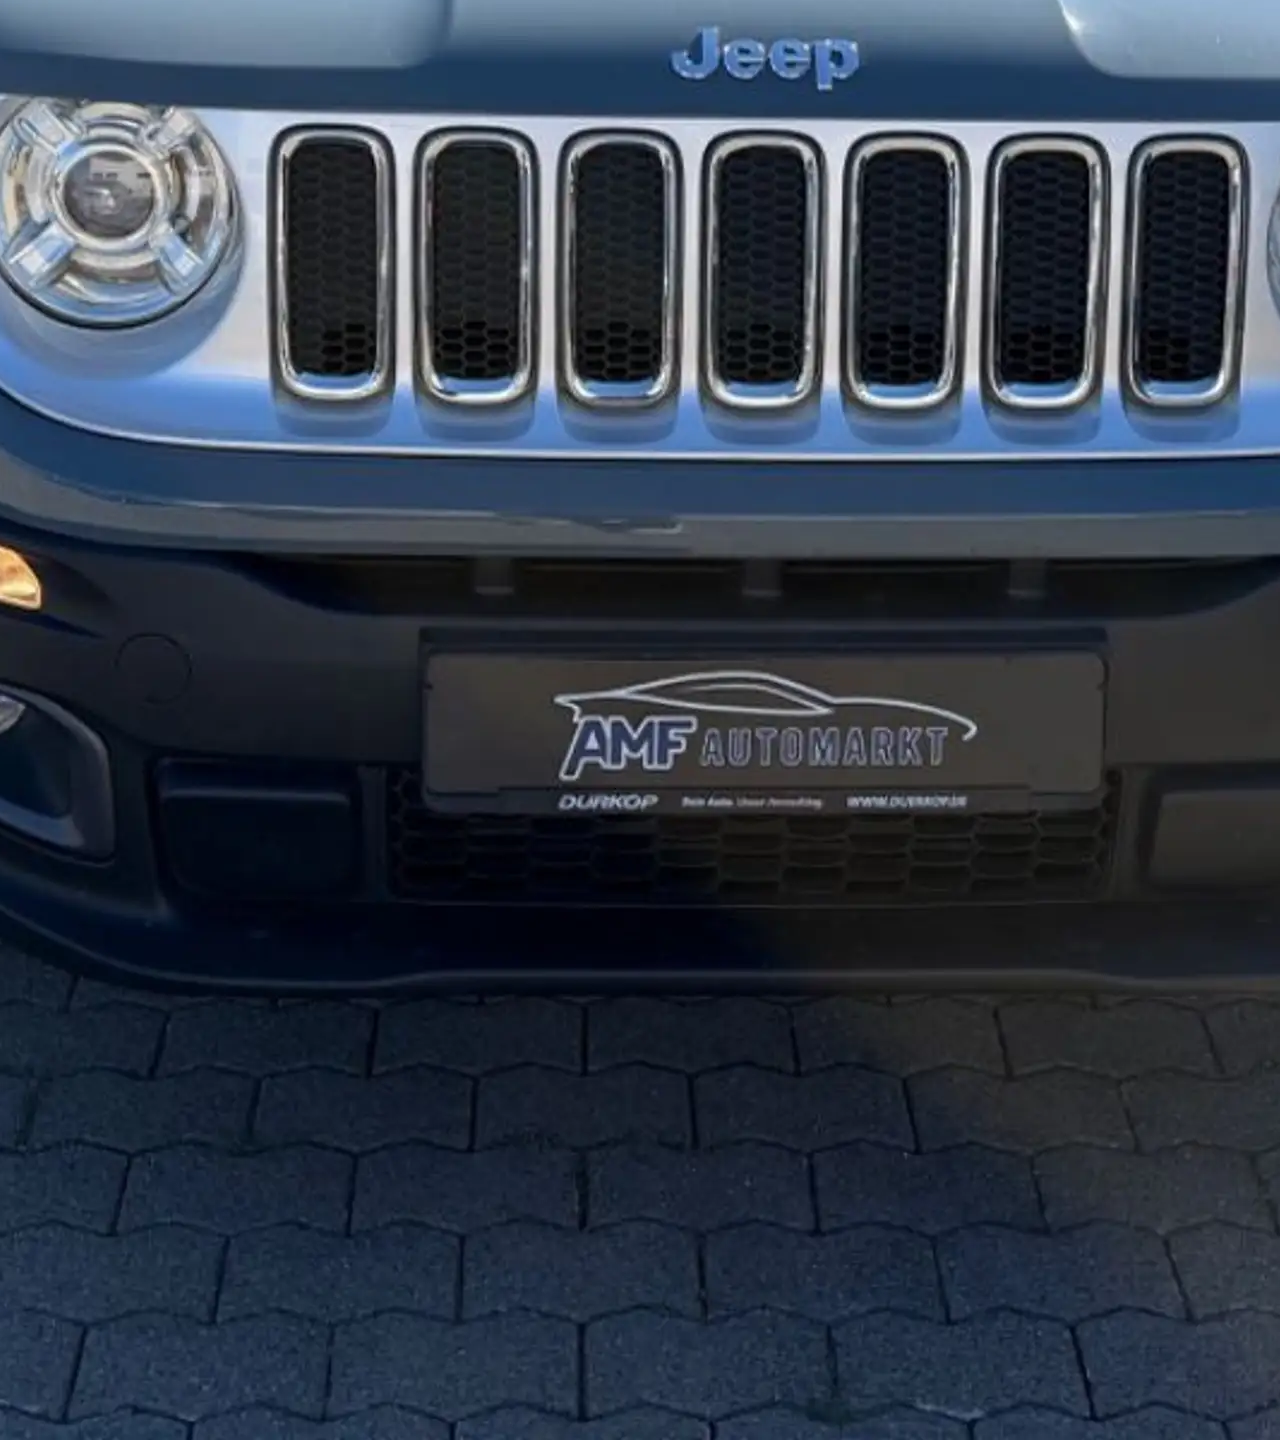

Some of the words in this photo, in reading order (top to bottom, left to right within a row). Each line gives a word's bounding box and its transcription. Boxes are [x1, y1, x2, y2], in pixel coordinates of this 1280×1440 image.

[671, 26, 860, 91] Jeep
[560, 714, 698, 781] AMF
[699, 727, 949, 767] AUTOMARKT
